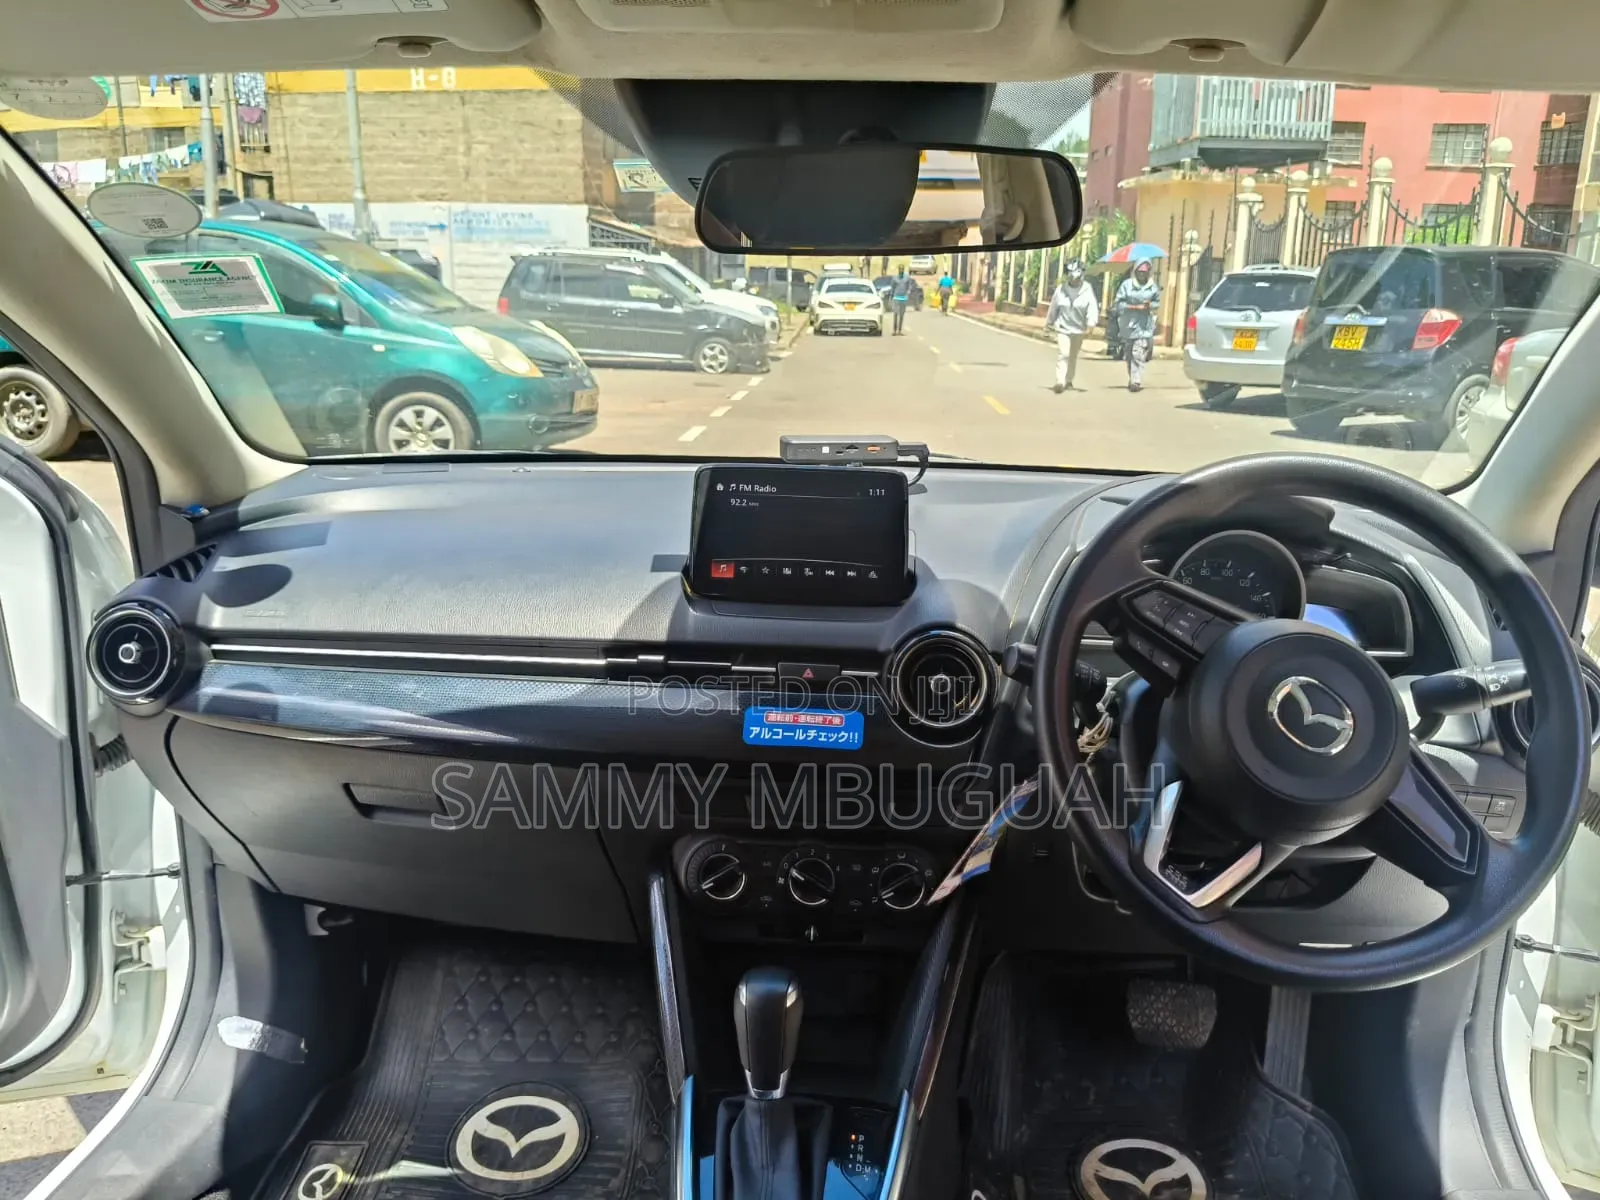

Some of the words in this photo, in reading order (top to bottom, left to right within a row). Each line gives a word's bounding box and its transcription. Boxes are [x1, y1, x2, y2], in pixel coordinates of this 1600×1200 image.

[739, 484, 752, 492] FM
[754, 484, 777, 493] Radio
[869, 488, 885, 497] 1:11
[730, 498, 747, 506] 92.2
[1200, 568, 1210, 576] 80
[1182, 577, 1192, 585] 60
[749, 726, 858, 743] アルコールチェック!!
[858, 1144, 863, 1152] R
[857, 1153, 863, 1162] N
[855, 1163, 862, 1172] D
